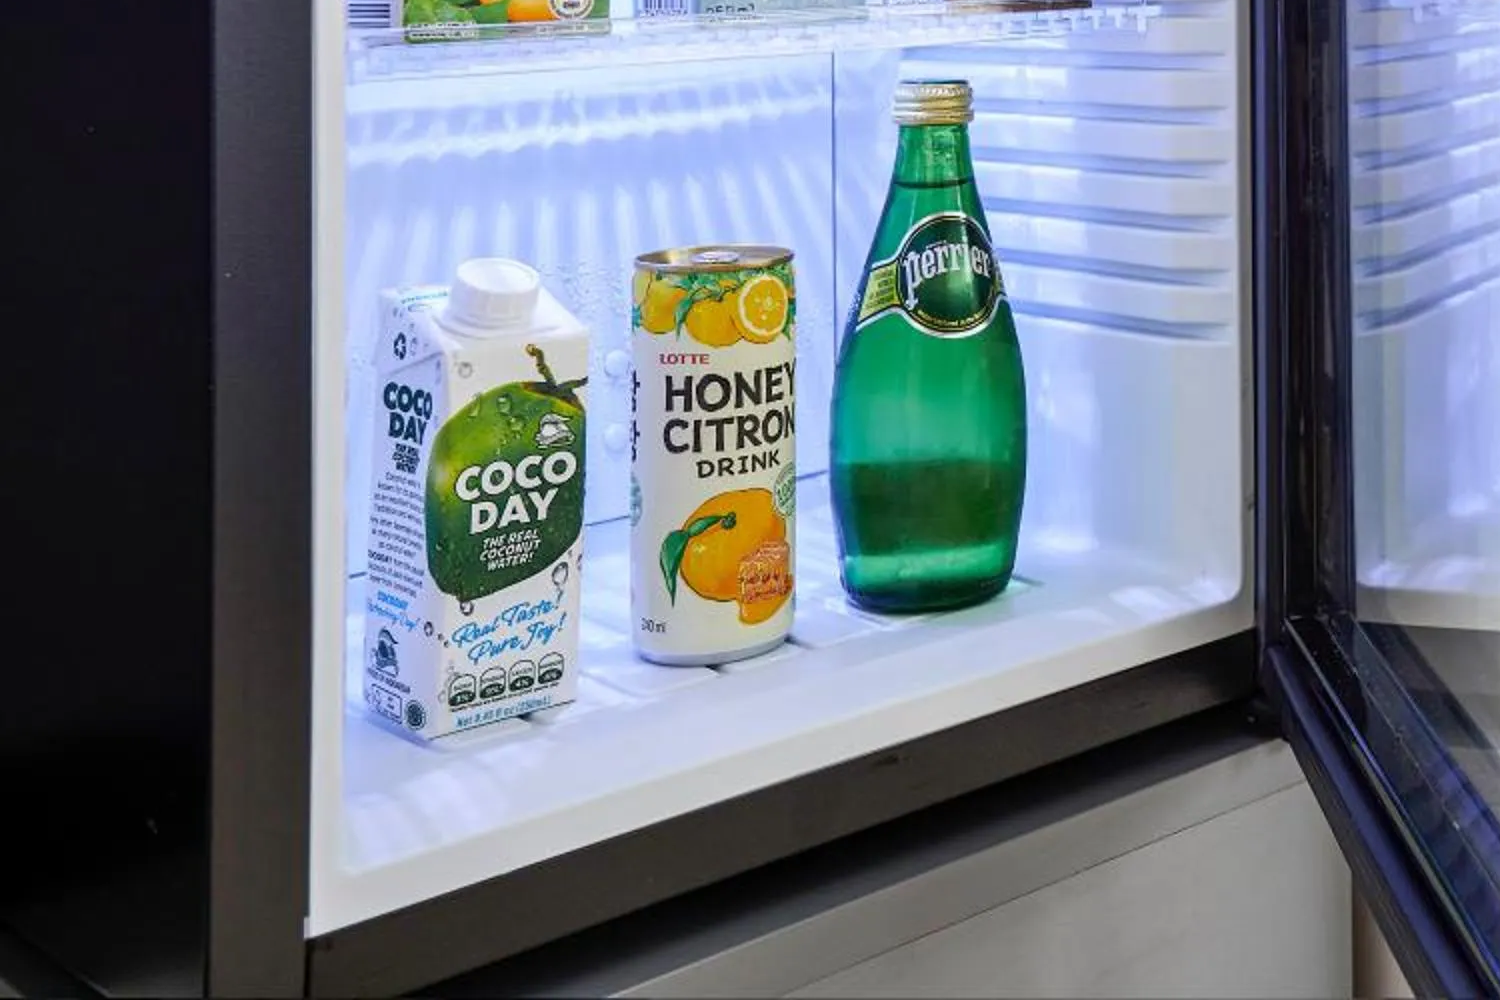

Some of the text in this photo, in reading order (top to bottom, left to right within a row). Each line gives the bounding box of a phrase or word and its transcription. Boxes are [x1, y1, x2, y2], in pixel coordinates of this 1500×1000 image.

[659, 353, 710, 366] LOTTE
[383, 381, 433, 420] COCO
[664, 356, 796, 413] HONEY
[388, 411, 427, 445] DAY
[663, 405, 796, 454] CITRON
[455, 451, 577, 501] COCO
[696, 449, 781, 479] DRINK
[469, 487, 559, 535] DAY
[479, 539, 542, 561] COCONUT
[482, 529, 539, 550] THE REAL
